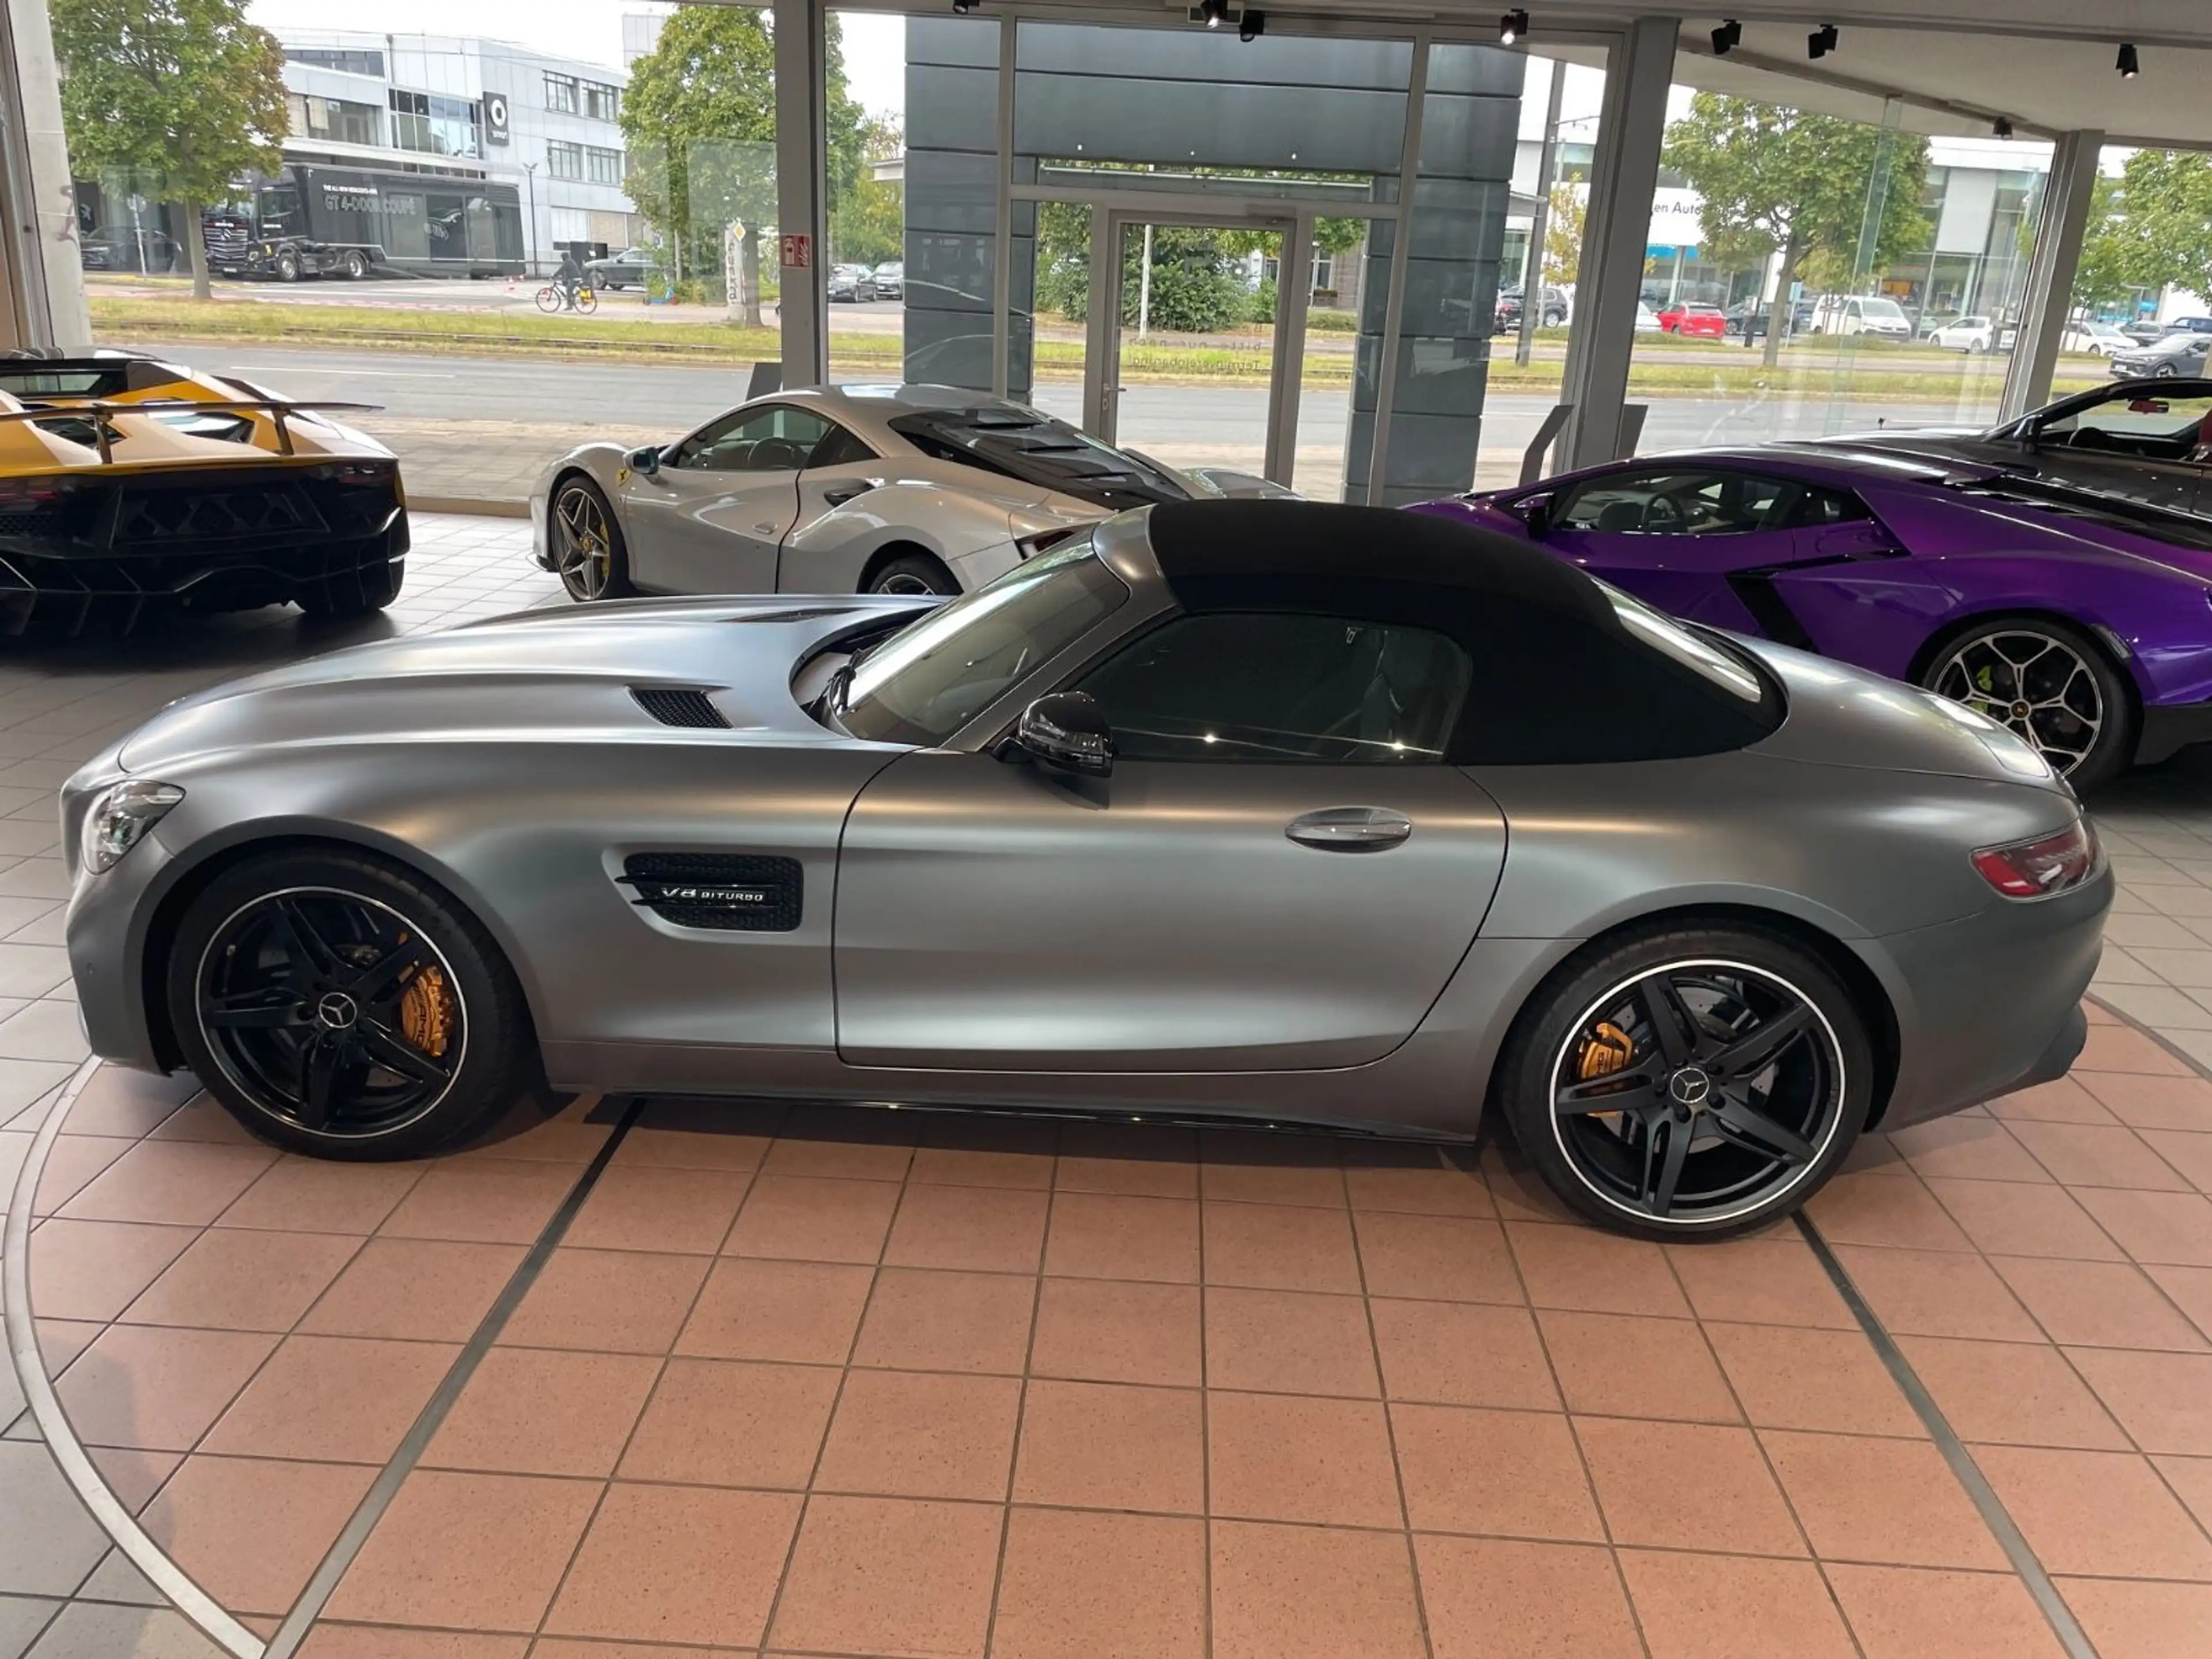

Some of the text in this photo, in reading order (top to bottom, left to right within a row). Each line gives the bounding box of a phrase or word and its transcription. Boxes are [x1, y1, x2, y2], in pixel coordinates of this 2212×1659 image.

[325, 195, 339, 211] GT
[661, 887, 763, 902] V8 BITURBO
